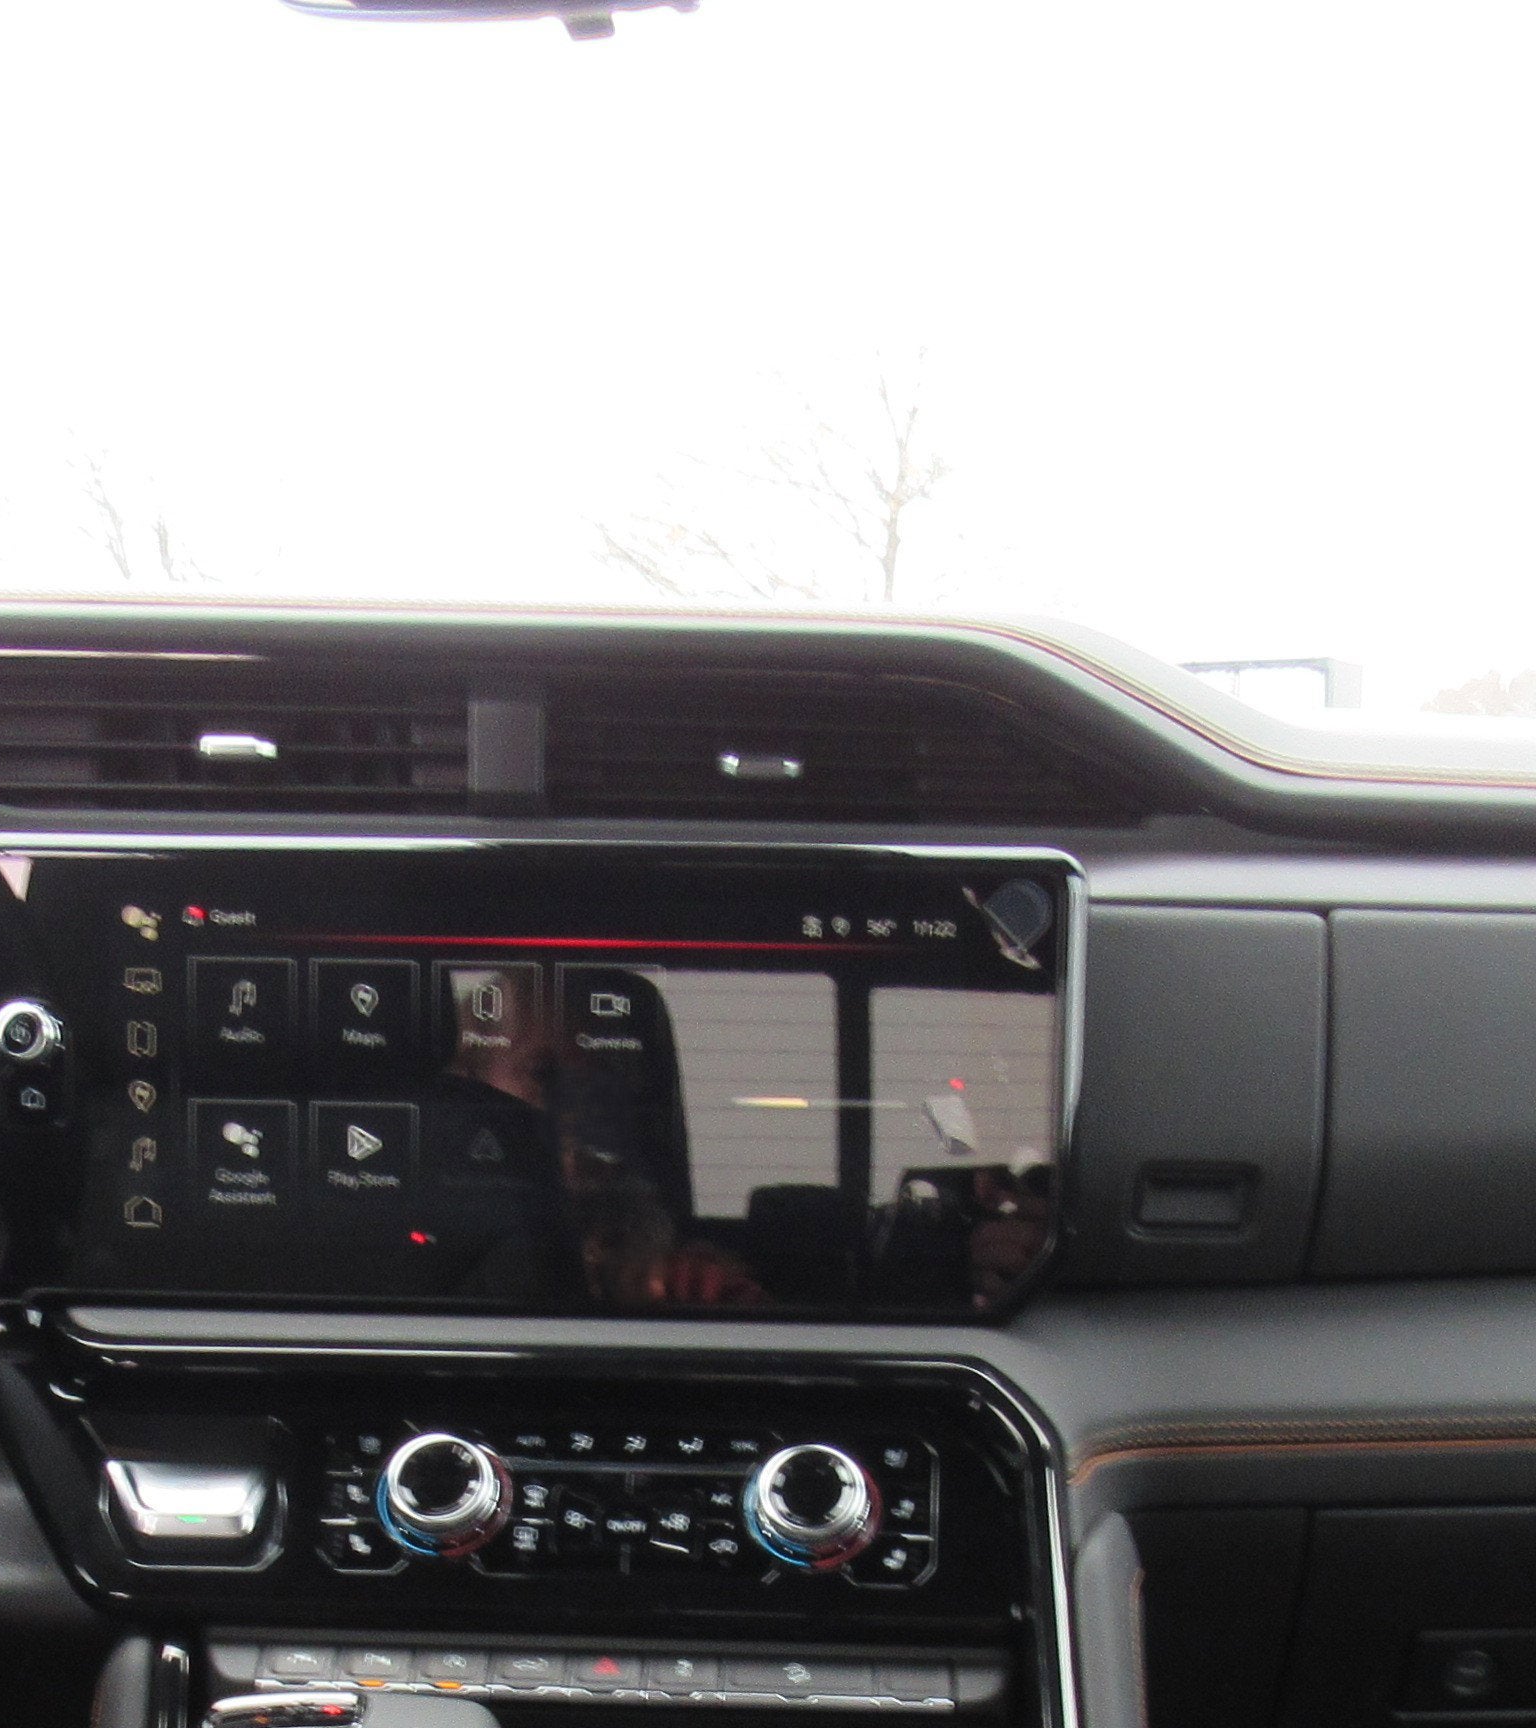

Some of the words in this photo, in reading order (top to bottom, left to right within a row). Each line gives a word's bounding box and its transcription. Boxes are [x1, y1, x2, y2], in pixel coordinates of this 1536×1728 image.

[219, 1026, 265, 1043] Audio
[342, 1028, 387, 1048] Maps
[463, 1031, 512, 1049] Phone
[576, 1033, 643, 1051] Cameras
[215, 1168, 271, 1188] Google
[327, 1170, 360, 1190] Play
[359, 1170, 401, 1188] Store
[209, 1188, 277, 1205] Assistant
